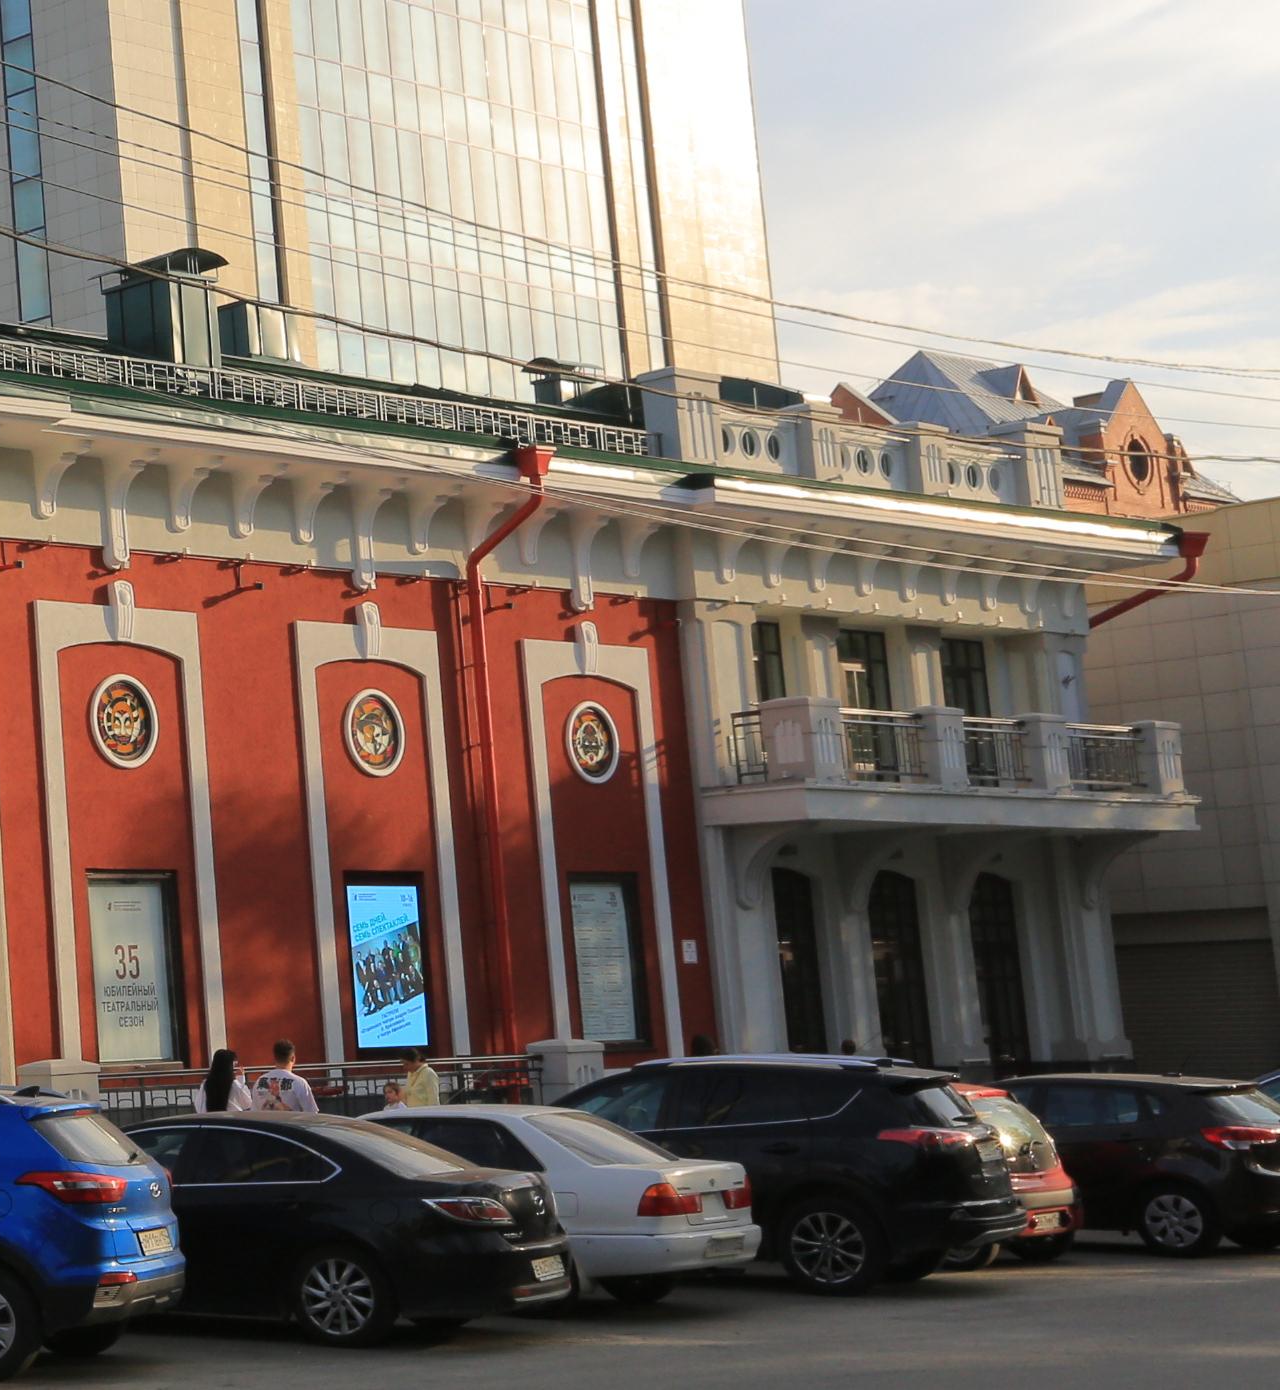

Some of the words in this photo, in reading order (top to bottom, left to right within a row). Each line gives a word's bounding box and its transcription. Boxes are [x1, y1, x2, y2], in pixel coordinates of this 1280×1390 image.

[114, 945, 140, 980] 35
[103, 982, 156, 997] ЮБИЛЕЙНЫЙ
[101, 997, 159, 1013] ТЕАТРАЛЬНЫЙ
[118, 1015, 145, 1028] СЕЗОН
